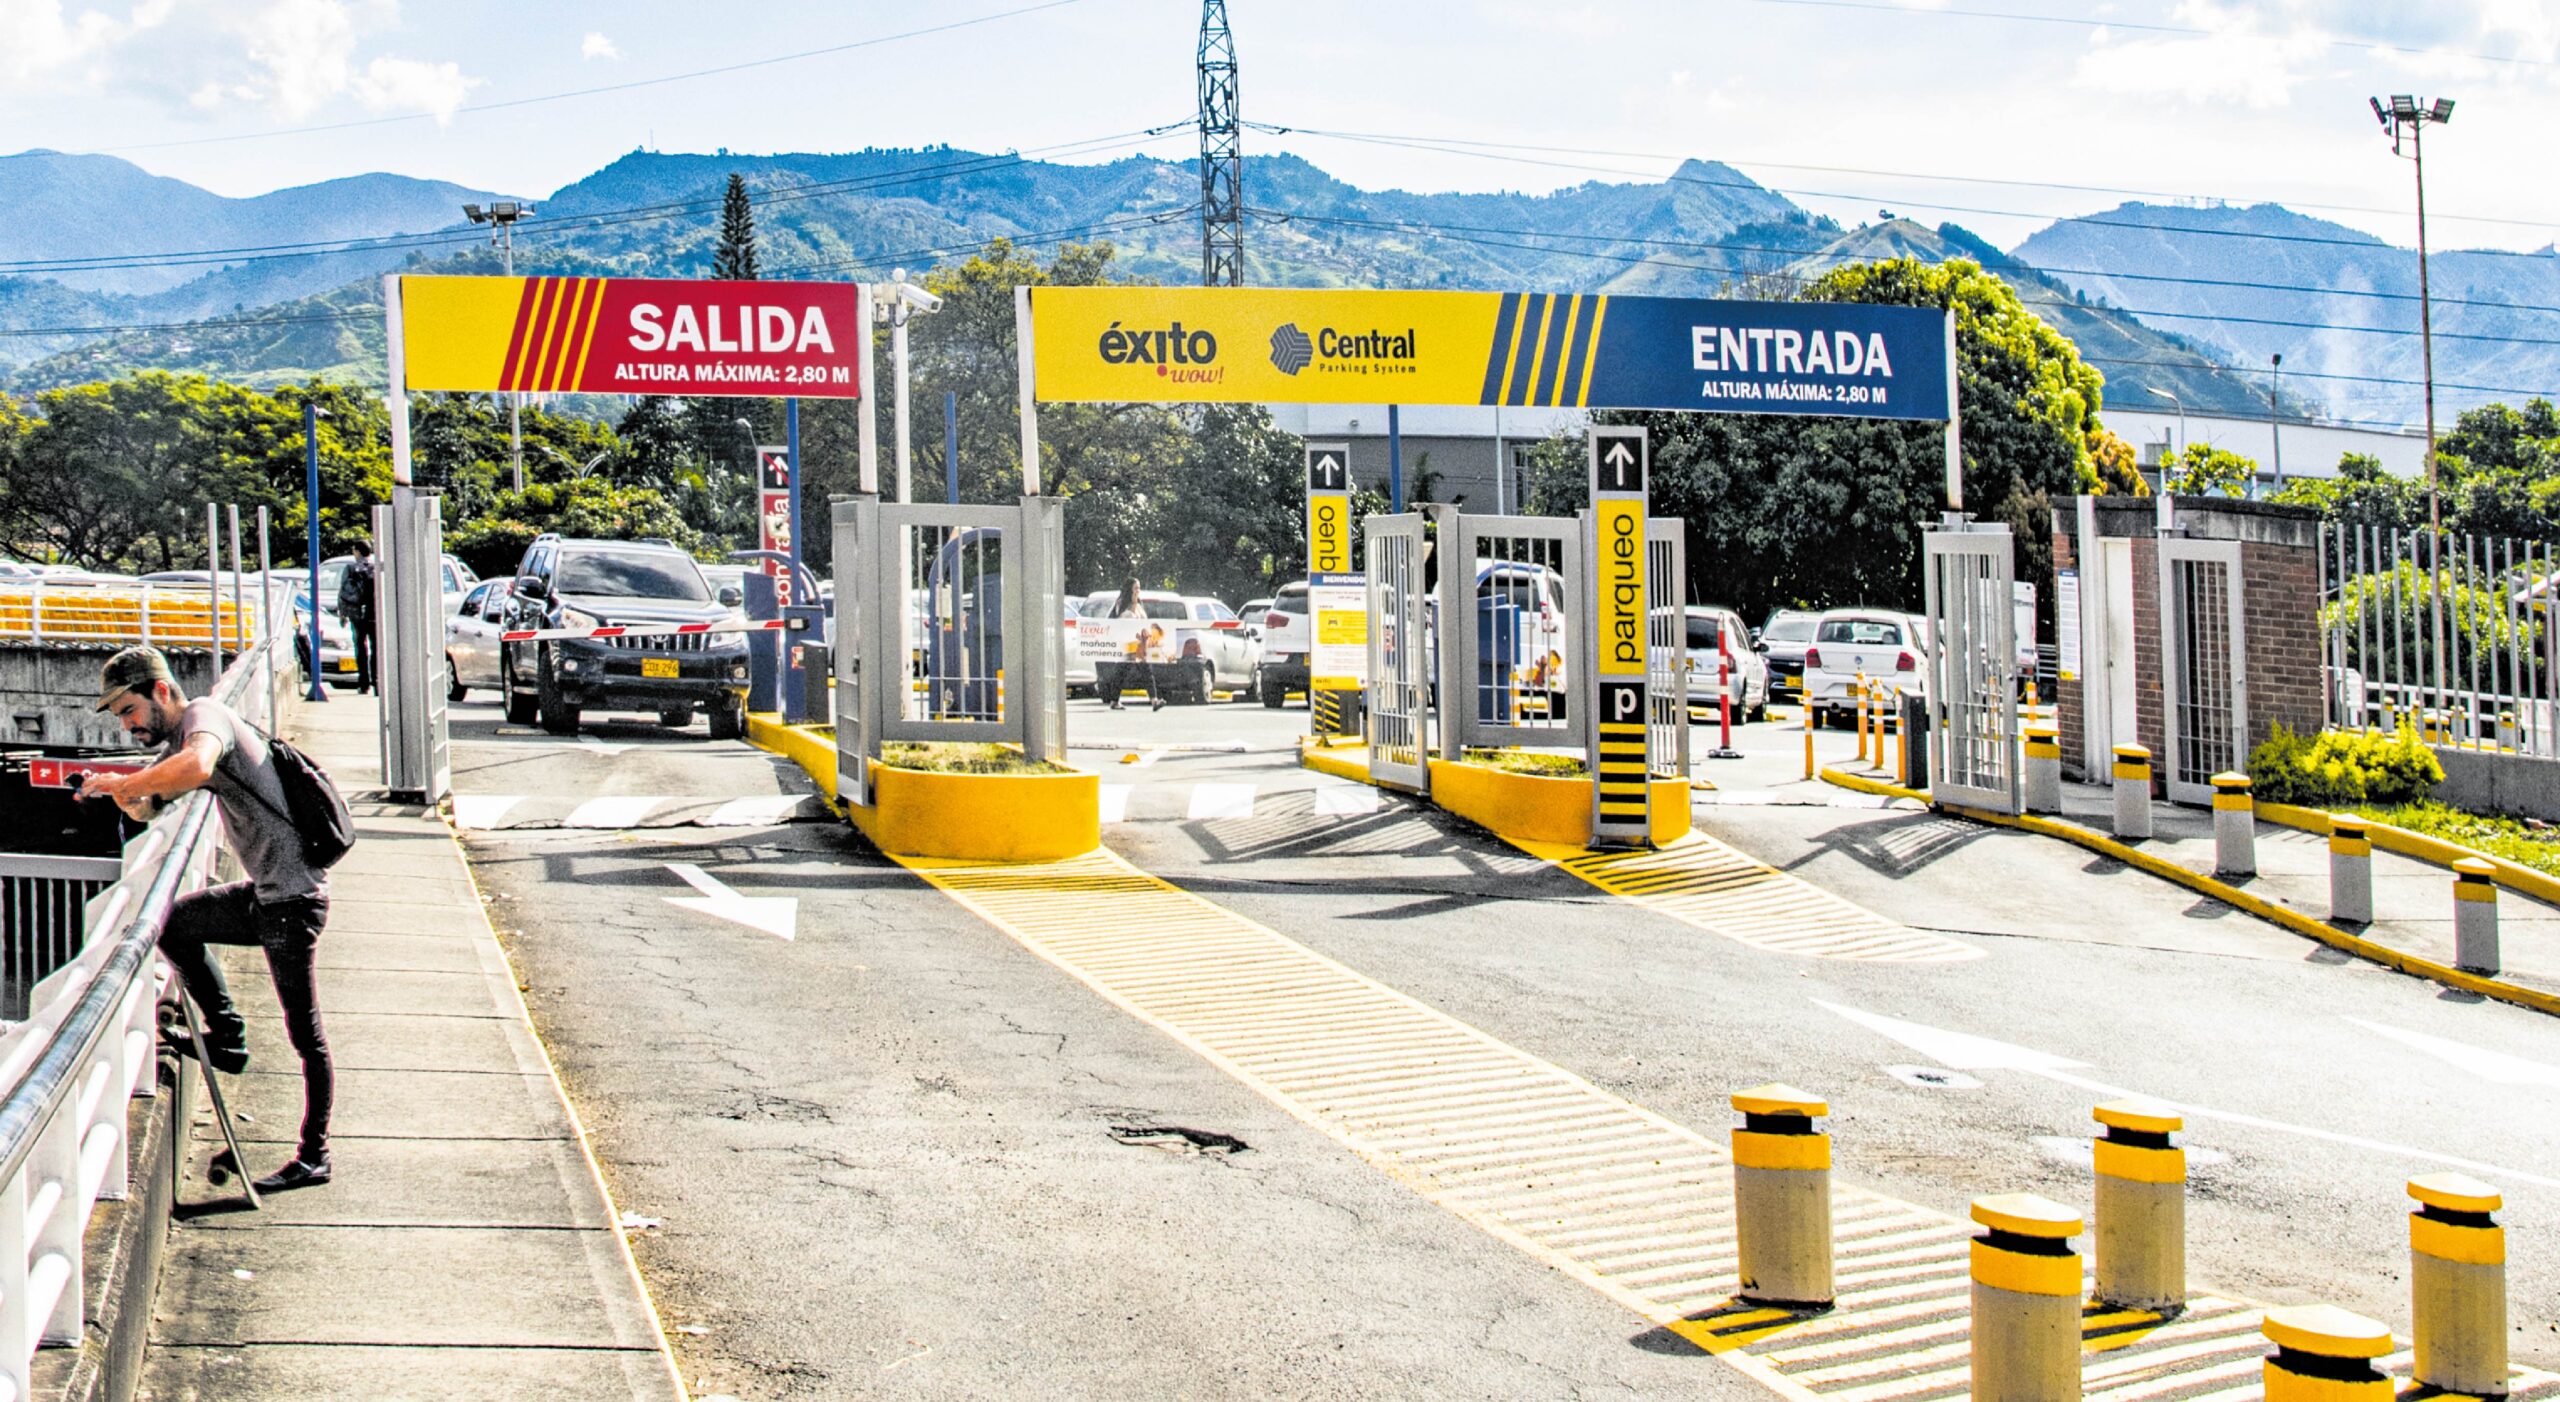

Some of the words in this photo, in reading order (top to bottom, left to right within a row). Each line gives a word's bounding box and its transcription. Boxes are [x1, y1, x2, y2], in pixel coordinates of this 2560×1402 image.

[628, 303, 835, 353] SALIDA
[1319, 328, 1415, 359] Central
[1099, 321, 1217, 377] éxito
[1691, 326, 1892, 377] ENTRADA
[615, 363, 690, 382] ALTURA
[694, 360, 780, 383] MÁXIMA:
[785, 365, 827, 386] 2,80
[833, 367, 850, 384] M
[1170, 366, 1225, 385] wow!
[1319, 362, 1369, 375] Parking
[1373, 363, 1417, 375] System
[1702, 381, 1762, 400] ALTURA
[1765, 379, 1832, 402] MÁXIMA:
[1836, 385, 1869, 405] 2,80
[1872, 387, 1886, 404] M
[1613, 514, 1642, 664] parqueo
[1080, 640, 1117, 648] mañana
[1615, 688, 1636, 720] p
